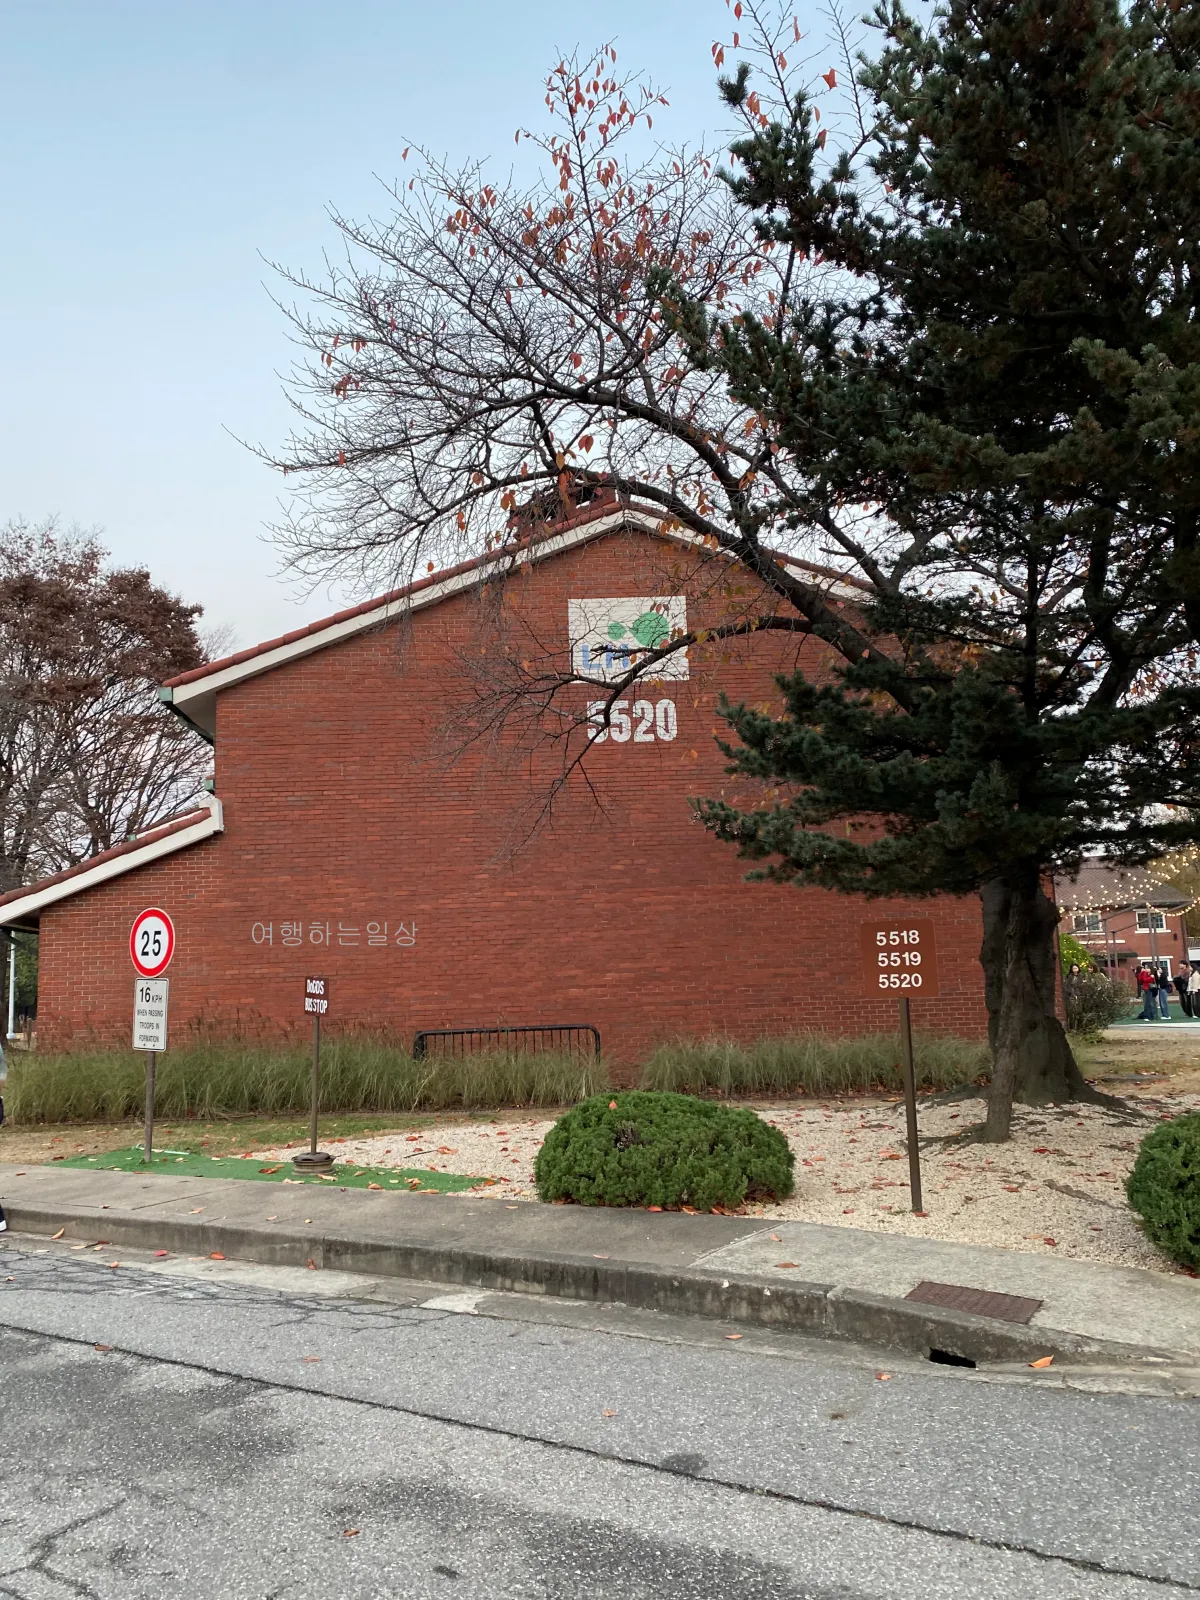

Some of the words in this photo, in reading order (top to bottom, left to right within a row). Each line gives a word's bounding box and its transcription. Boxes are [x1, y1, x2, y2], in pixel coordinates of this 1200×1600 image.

[587, 699, 677, 743] 5520
[251, 921, 419, 947] 여행하는일상
[876, 930, 920, 946] 5518
[141, 931, 161, 956] 25
[878, 951, 921, 967] 5519
[879, 973, 922, 989] 5520
[139, 986, 151, 1003] 16
[151, 994, 163, 1003] KPH
[137, 1009, 148, 1017] WHEN
[148, 1009, 163, 1018] PASSING
[312, 999, 328, 1014] STOP
[139, 1021, 155, 1030] TROOPS
[155, 1022, 160, 1030] IN
[138, 1034, 160, 1043] FORMATION
